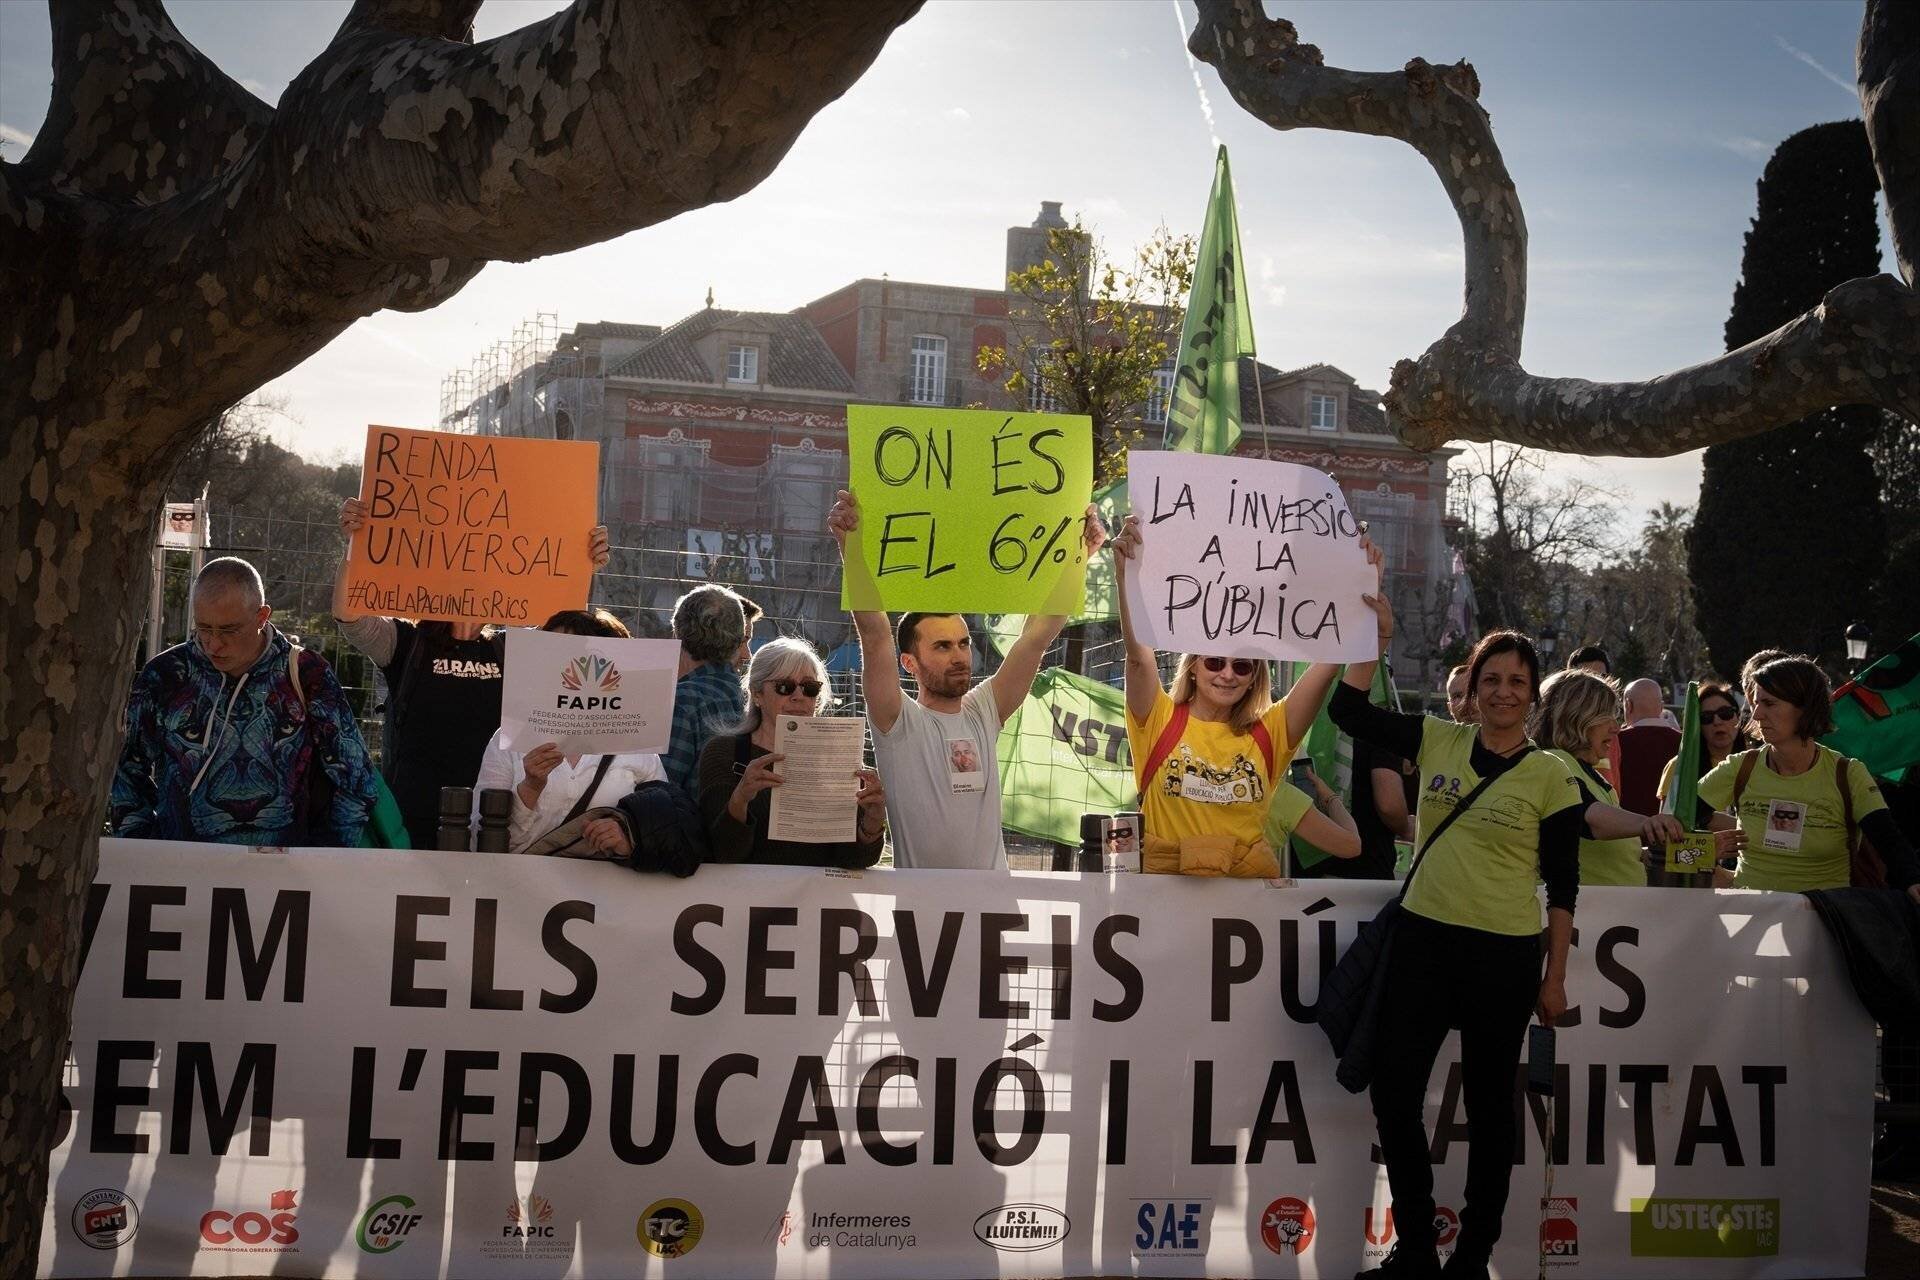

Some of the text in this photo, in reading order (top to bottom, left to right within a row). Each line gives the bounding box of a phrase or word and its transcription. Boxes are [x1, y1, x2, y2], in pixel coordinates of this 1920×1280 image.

[376, 432, 499, 484] RENDA
[875, 417, 1066, 496] ON ÉS
[370, 477, 510, 530] BÀSICA
[1149, 476, 1196, 525] LA
[367, 524, 569, 578] UNIVERSAL
[876, 512, 956, 578] EL
[1199, 535, 1298, 575] A LA
[1164, 571, 1342, 646] PÚBLICA
[557, 695, 622, 710] FAPIC
[528, 717, 590, 728] PROFESSIONALS
[532, 709, 576, 721] FEDERACIÓ
[1050, 703, 1134, 767] UST
[390, 894, 598, 1014] ELS
[670, 903, 1144, 1022] SERVEIS
[49, 1032, 1787, 1168] EM L'EDUCACIÓ I LA ANITAT
[90, 1212, 121, 1229] CNT
[200, 1210, 299, 1244] COS
[368, 1213, 423, 1236] CSIF
[644, 1218, 686, 1237] FTC
[812, 1212, 911, 1228] Infermeres
[1006, 1211, 1039, 1224] P.S.I.
[503, 1226, 554, 1238] FAPIC
[809, 1230, 916, 1250] de Catalunya
[986, 1226, 1058, 1239] LLUITEM!!!
[1756, 1233, 1773, 1247] IAC
[1542, 1240, 1575, 1254] CGT
